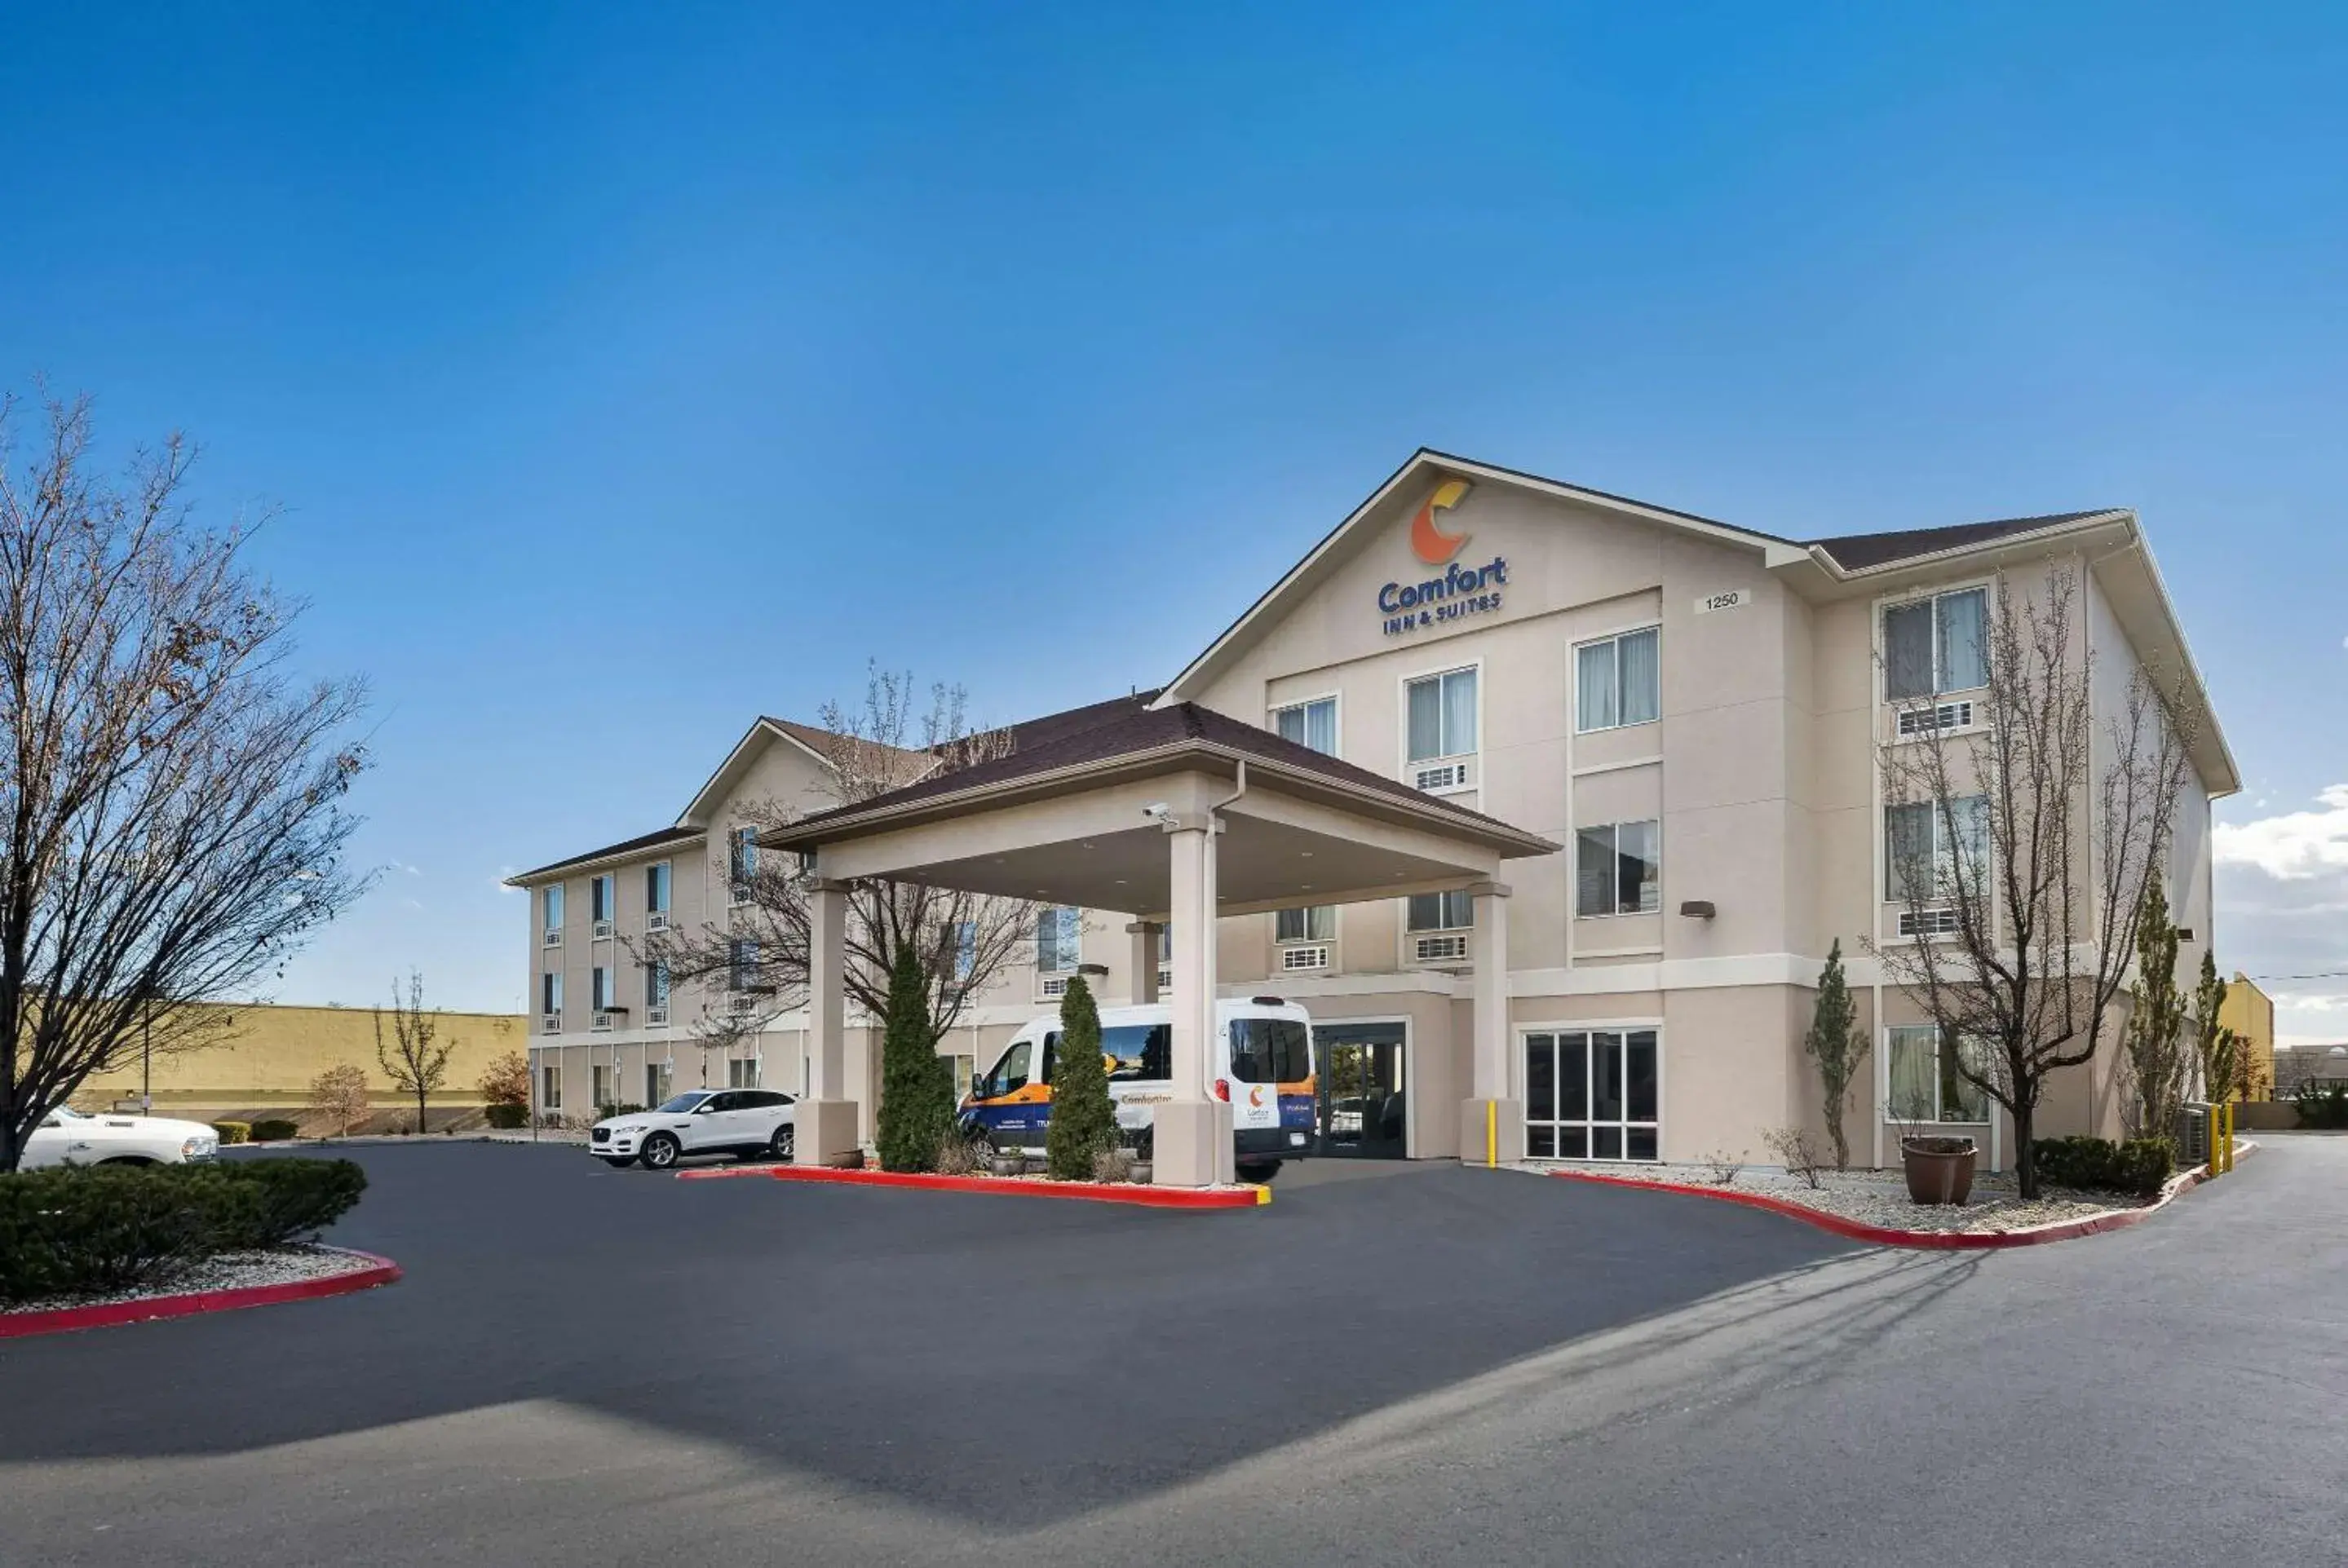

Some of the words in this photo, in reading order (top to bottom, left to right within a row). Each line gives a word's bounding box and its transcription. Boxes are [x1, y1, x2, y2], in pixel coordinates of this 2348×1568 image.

[1378, 557, 1507, 613] Comfort
[1383, 615, 1416, 635] INN
[1419, 612, 1431, 625] &
[1436, 592, 1501, 621] SUITES
